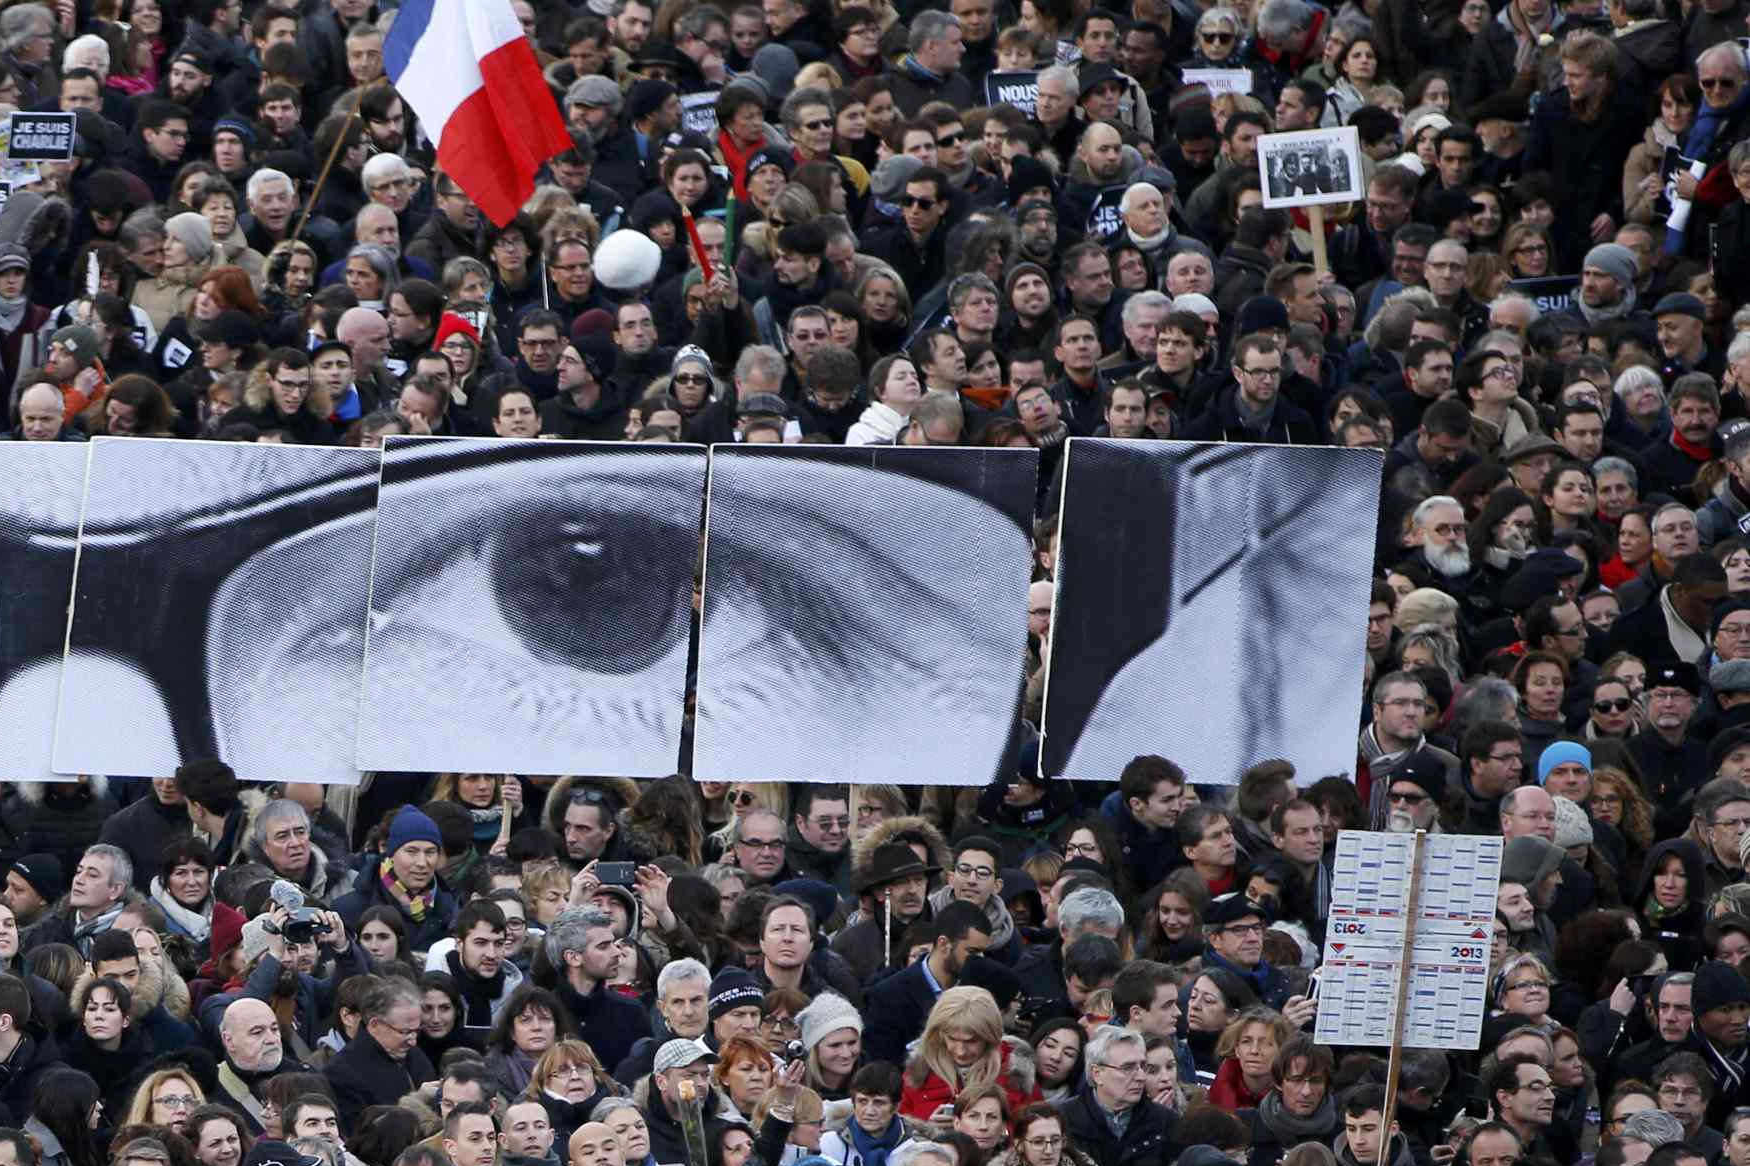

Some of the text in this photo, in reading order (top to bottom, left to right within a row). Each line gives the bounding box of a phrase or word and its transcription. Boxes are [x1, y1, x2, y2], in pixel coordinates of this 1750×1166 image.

[14, 122, 70, 133] JE SUIS
[13, 134, 69, 149] CHARLIE
[1536, 294, 1570, 312] SUI
[1451, 947, 1483, 958] 2013
